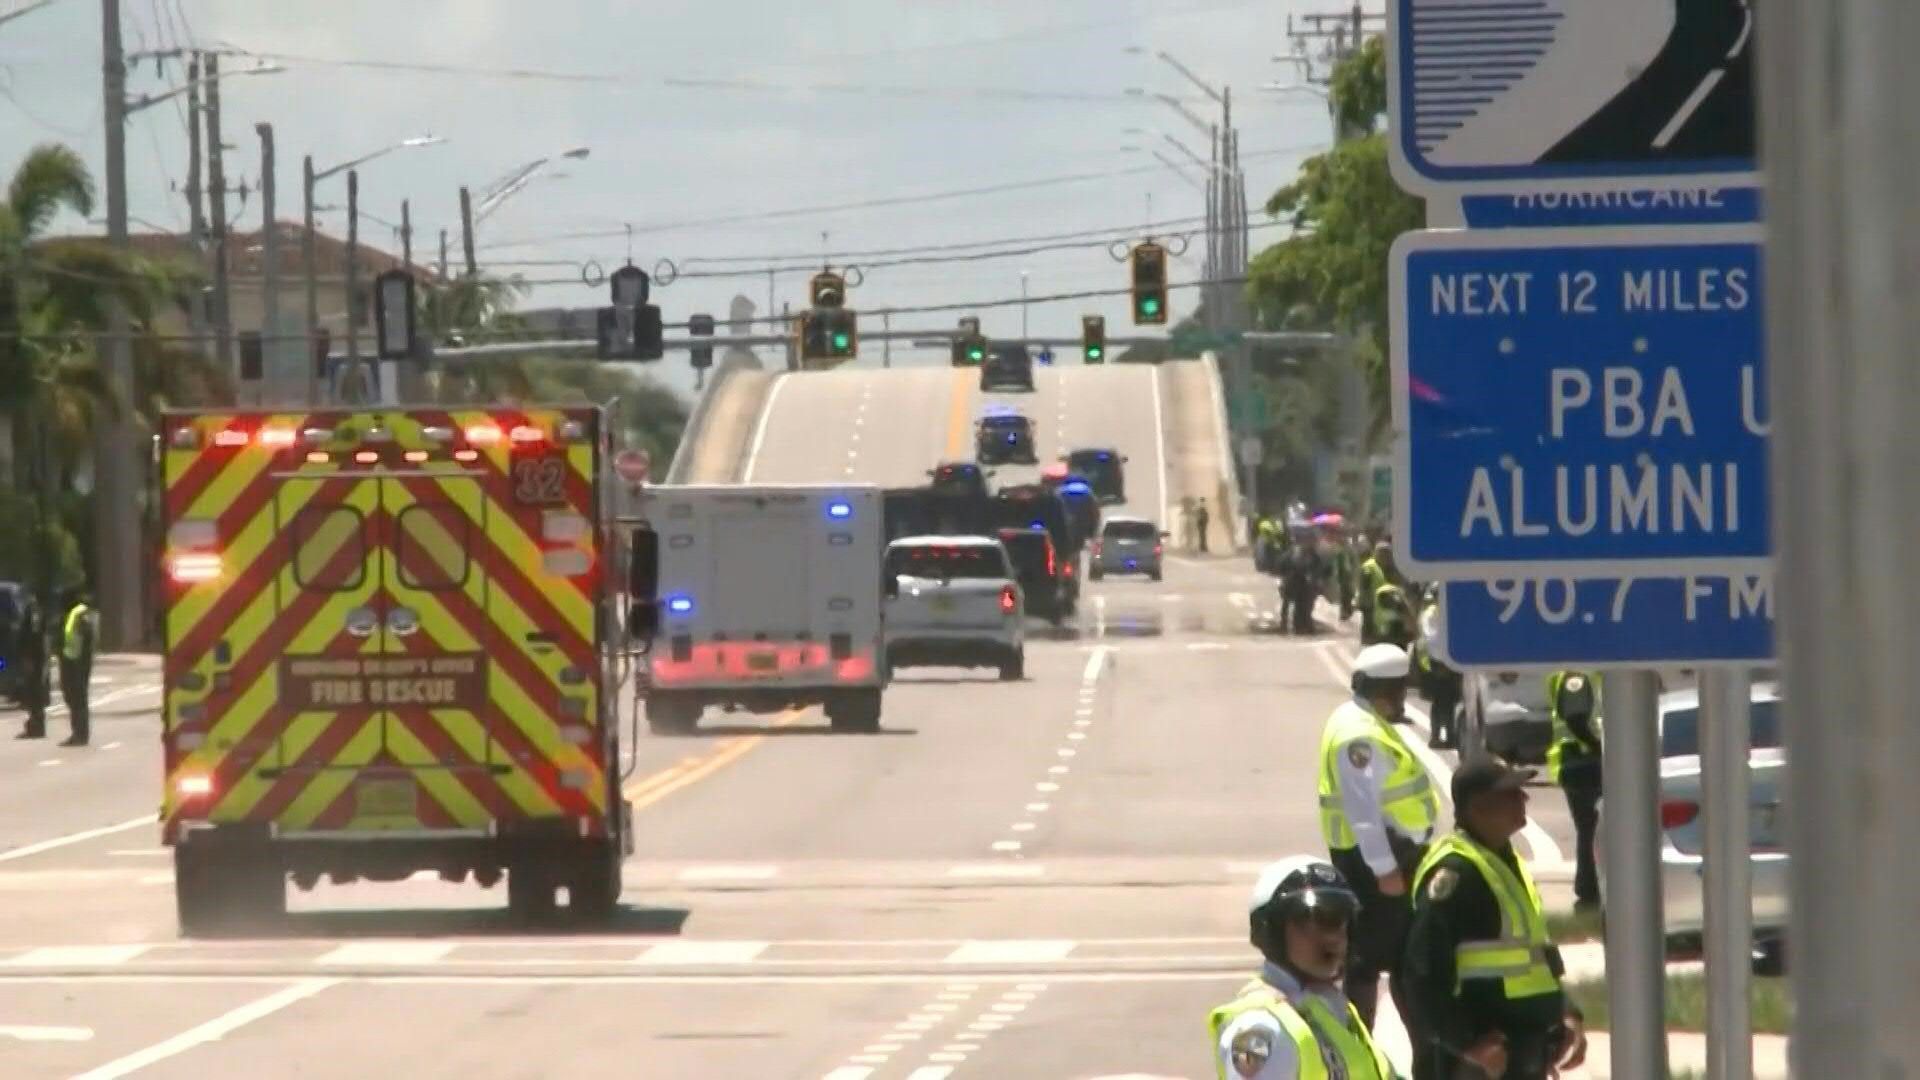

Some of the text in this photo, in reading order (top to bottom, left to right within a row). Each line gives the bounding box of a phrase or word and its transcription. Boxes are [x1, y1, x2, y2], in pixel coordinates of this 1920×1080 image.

[1432, 268, 1749, 315] NEXT 12 MILES
[1551, 367, 1695, 438] PBA
[1460, 463, 1738, 537] ALUMNI
[1485, 576, 1775, 624] 90.7 FM
[311, 679, 362, 703] FIRE
